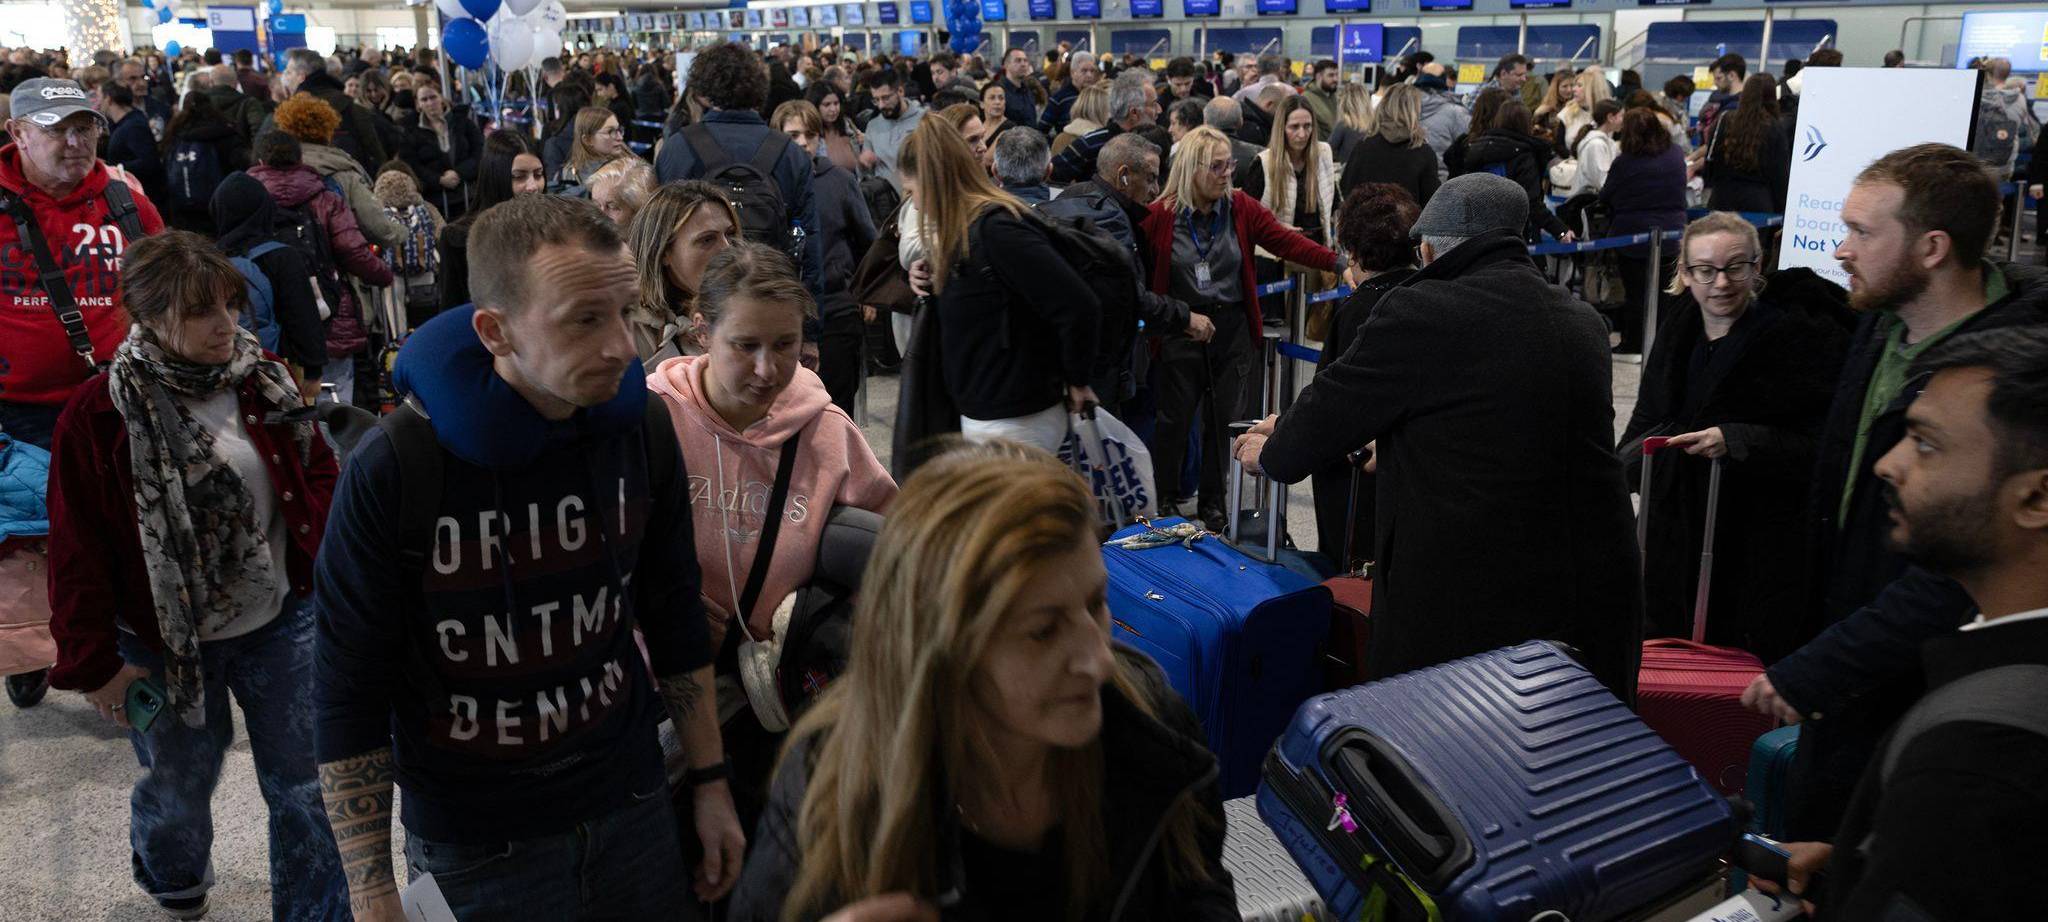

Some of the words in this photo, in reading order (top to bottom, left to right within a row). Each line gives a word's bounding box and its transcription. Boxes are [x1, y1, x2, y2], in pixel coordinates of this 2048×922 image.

[211, 12, 223, 26] B
[274, 18, 287, 30] C
[1798, 193, 1846, 211] Read
[72, 223, 124, 256] 20
[1793, 234, 1826, 252] Not
[1832, 239, 1844, 249] Y
[2, 270, 118, 296] DID
[13, 296, 113, 307] PERFANCE
[687, 474, 809, 523] Adids
[435, 586, 622, 667] CNTM
